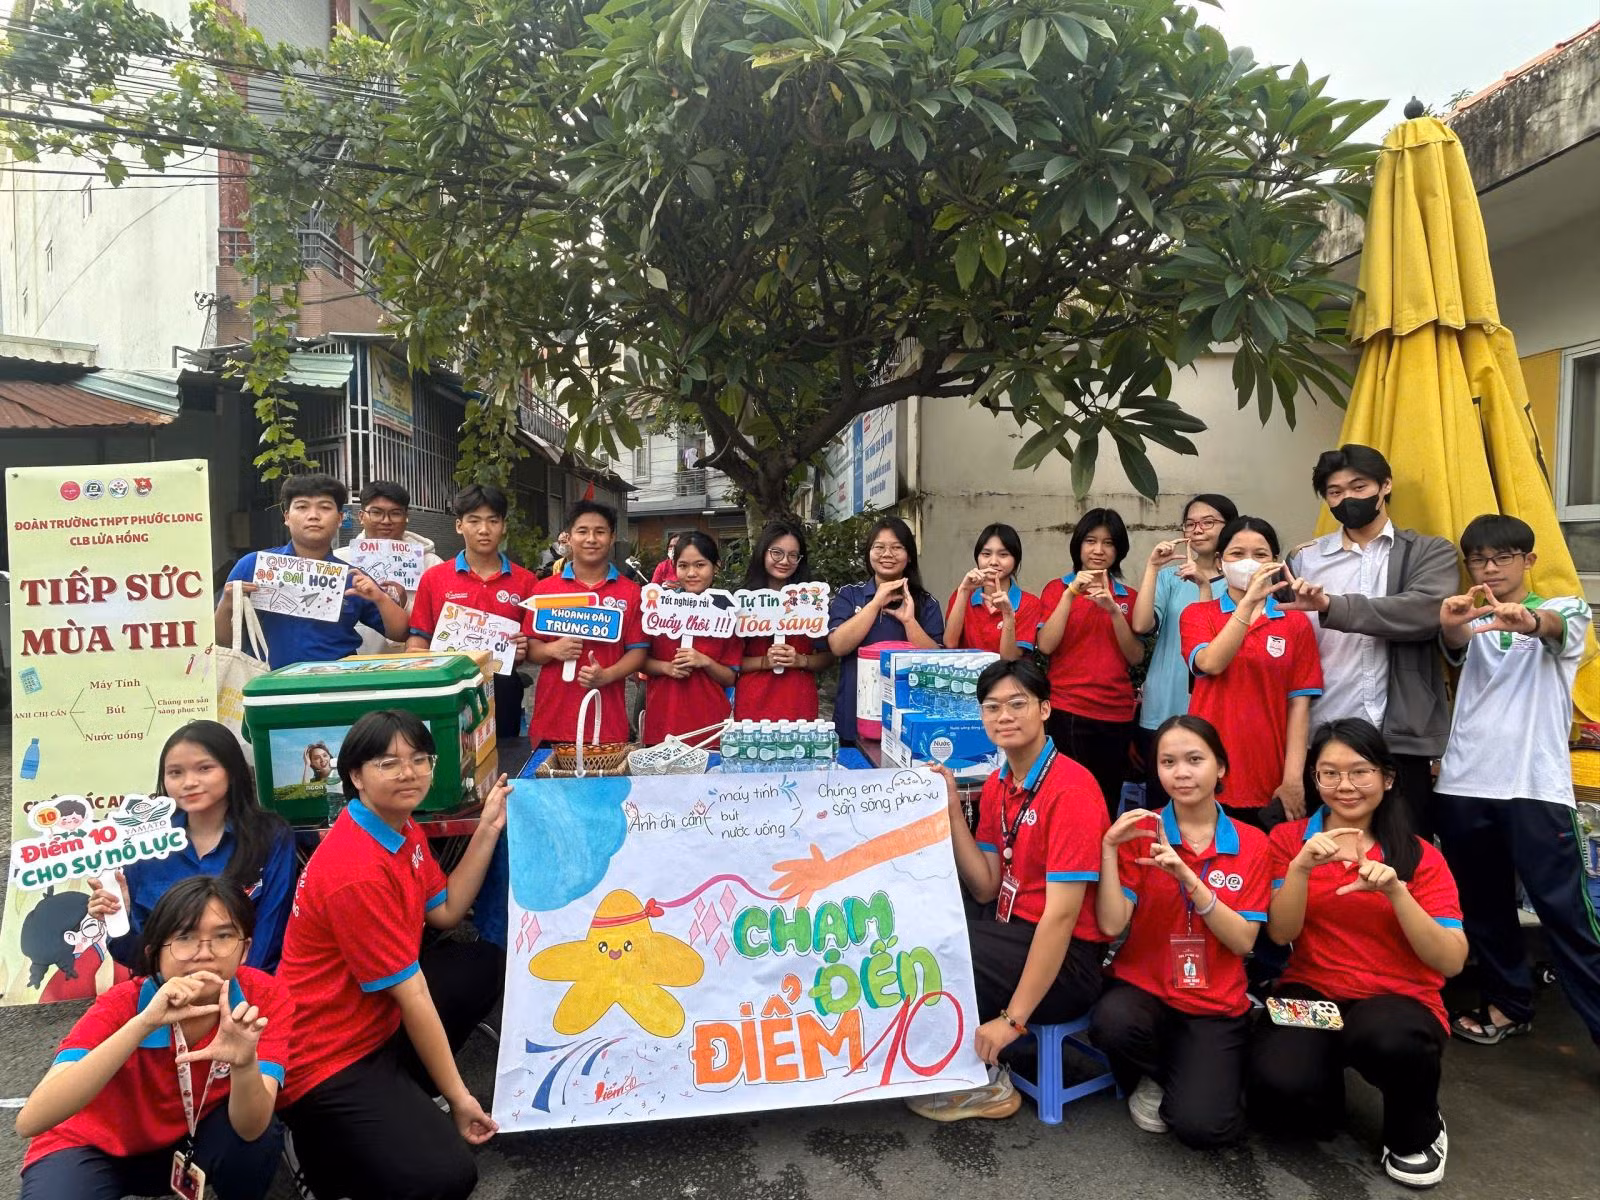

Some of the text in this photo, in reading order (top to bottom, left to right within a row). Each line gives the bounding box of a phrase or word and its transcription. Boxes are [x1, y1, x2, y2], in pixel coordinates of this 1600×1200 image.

[14, 511, 204, 531] ĐOÀN TRƯỜNG THPT PHƯỚC LONG
[69, 535, 90, 546] CLB
[92, 532, 114, 545] LỬA
[391, 542, 411, 554] HỌC
[315, 561, 343, 577] TÂM
[20, 564, 203, 607] TIẾP SỨC
[308, 574, 337, 591] HỌC
[660, 595, 673, 606] Tốt
[673, 596, 698, 609] nghiệp
[738, 593, 780, 611] Tự Tin
[551, 607, 590, 621] KHOANH
[737, 613, 825, 633] Tỏa sáng
[545, 618, 609, 637] TRÚNG ĐÓ
[646, 612, 683, 635] Quẩy
[713, 616, 732, 633] !!!
[20, 618, 198, 656] MÙA THI
[90, 678, 141, 691] Máy Tính
[106, 704, 126, 714] Bút
[85, 729, 144, 742] Nước uống
[719, 783, 779, 804] máy tính
[818, 782, 883, 799] Chúng em
[38, 811, 57, 824] 10
[629, 814, 657, 832] Anh
[125, 820, 167, 835] YAMATO
[754, 819, 785, 838] uống
[20, 825, 117, 864] Điểm 10
[21, 862, 67, 887] CHO
[72, 850, 102, 873] SỰ
[140, 832, 183, 860] LỰC
[731, 889, 896, 964] CHẠM
[689, 972, 965, 1089] ĐIỂM 10
